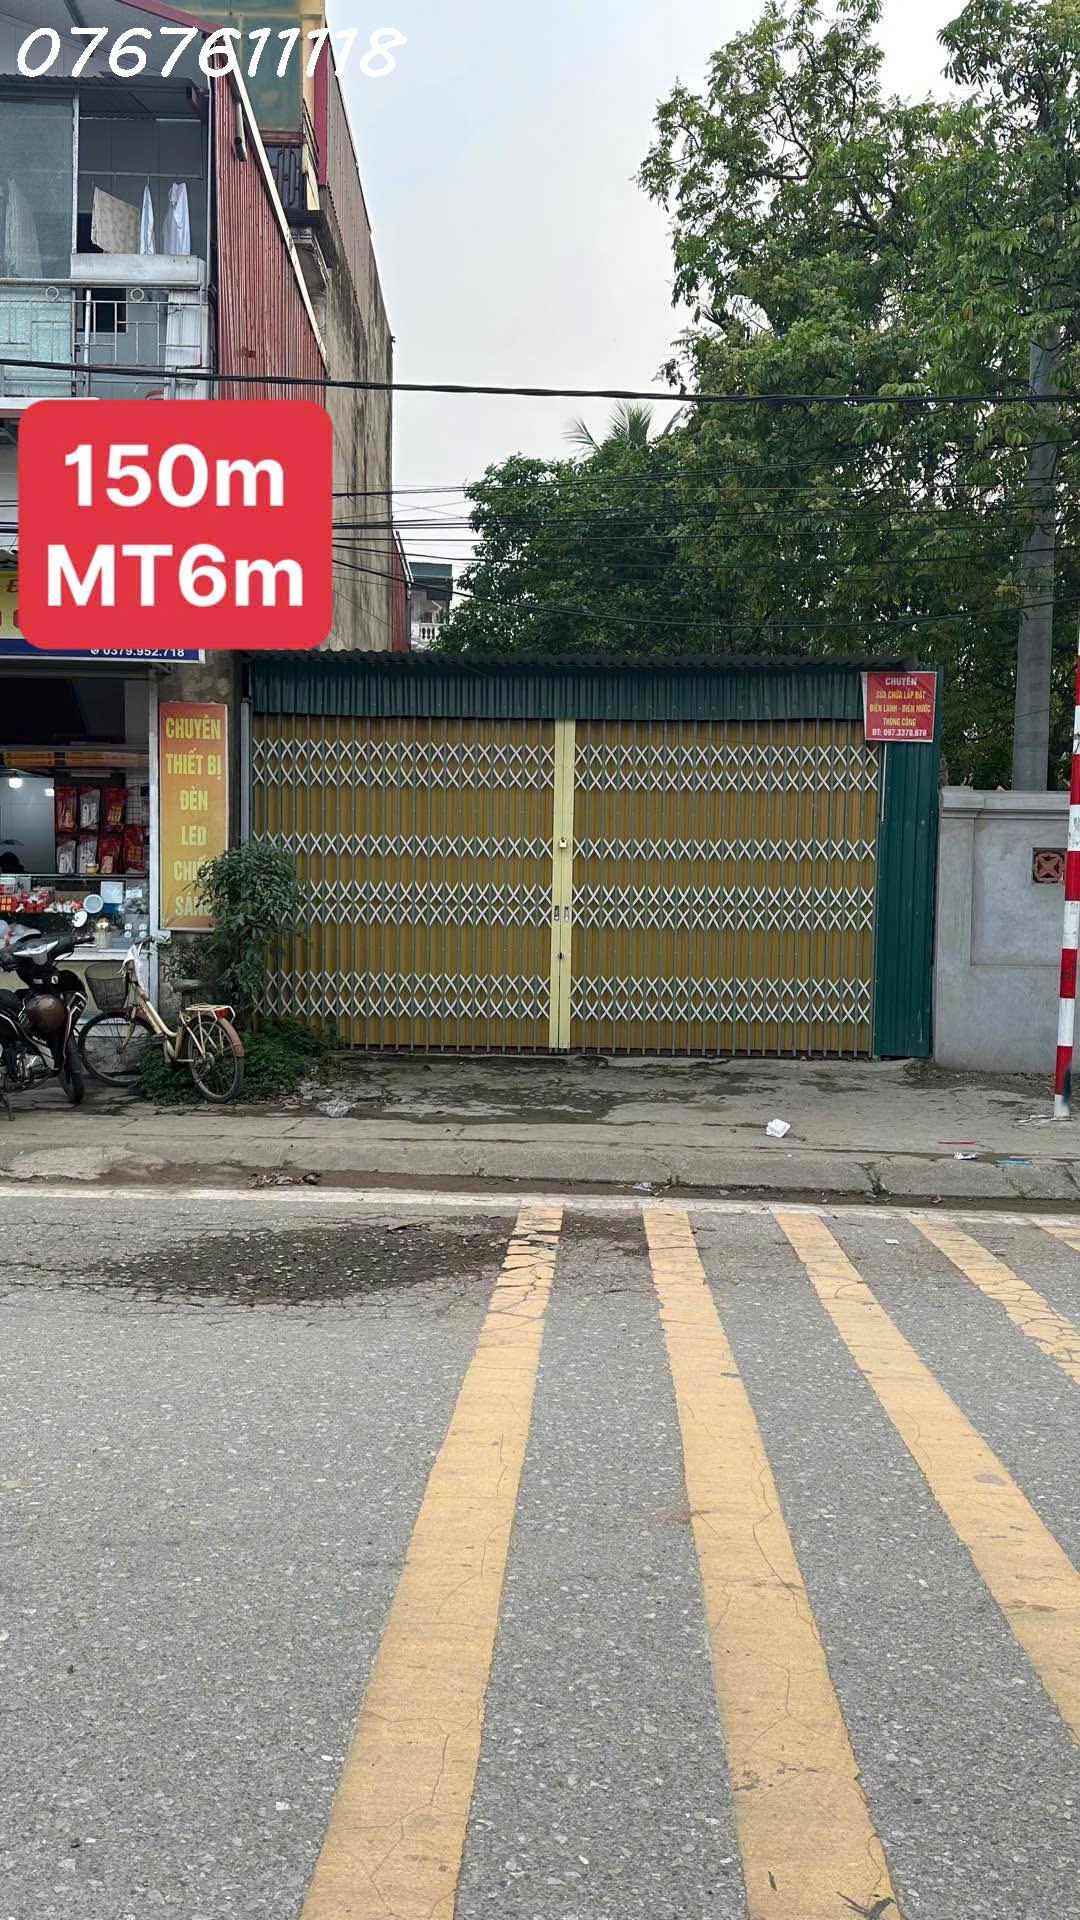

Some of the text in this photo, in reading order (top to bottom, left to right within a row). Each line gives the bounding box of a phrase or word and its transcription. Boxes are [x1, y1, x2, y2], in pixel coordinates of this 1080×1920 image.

[885, 676, 917, 686] CHUYÊN
[165, 714, 221, 739] CHUYÊN
[166, 748, 221, 780] THIẾT BỊ
[179, 786, 208, 811] ĐÈN
[181, 826, 207, 846] LED
